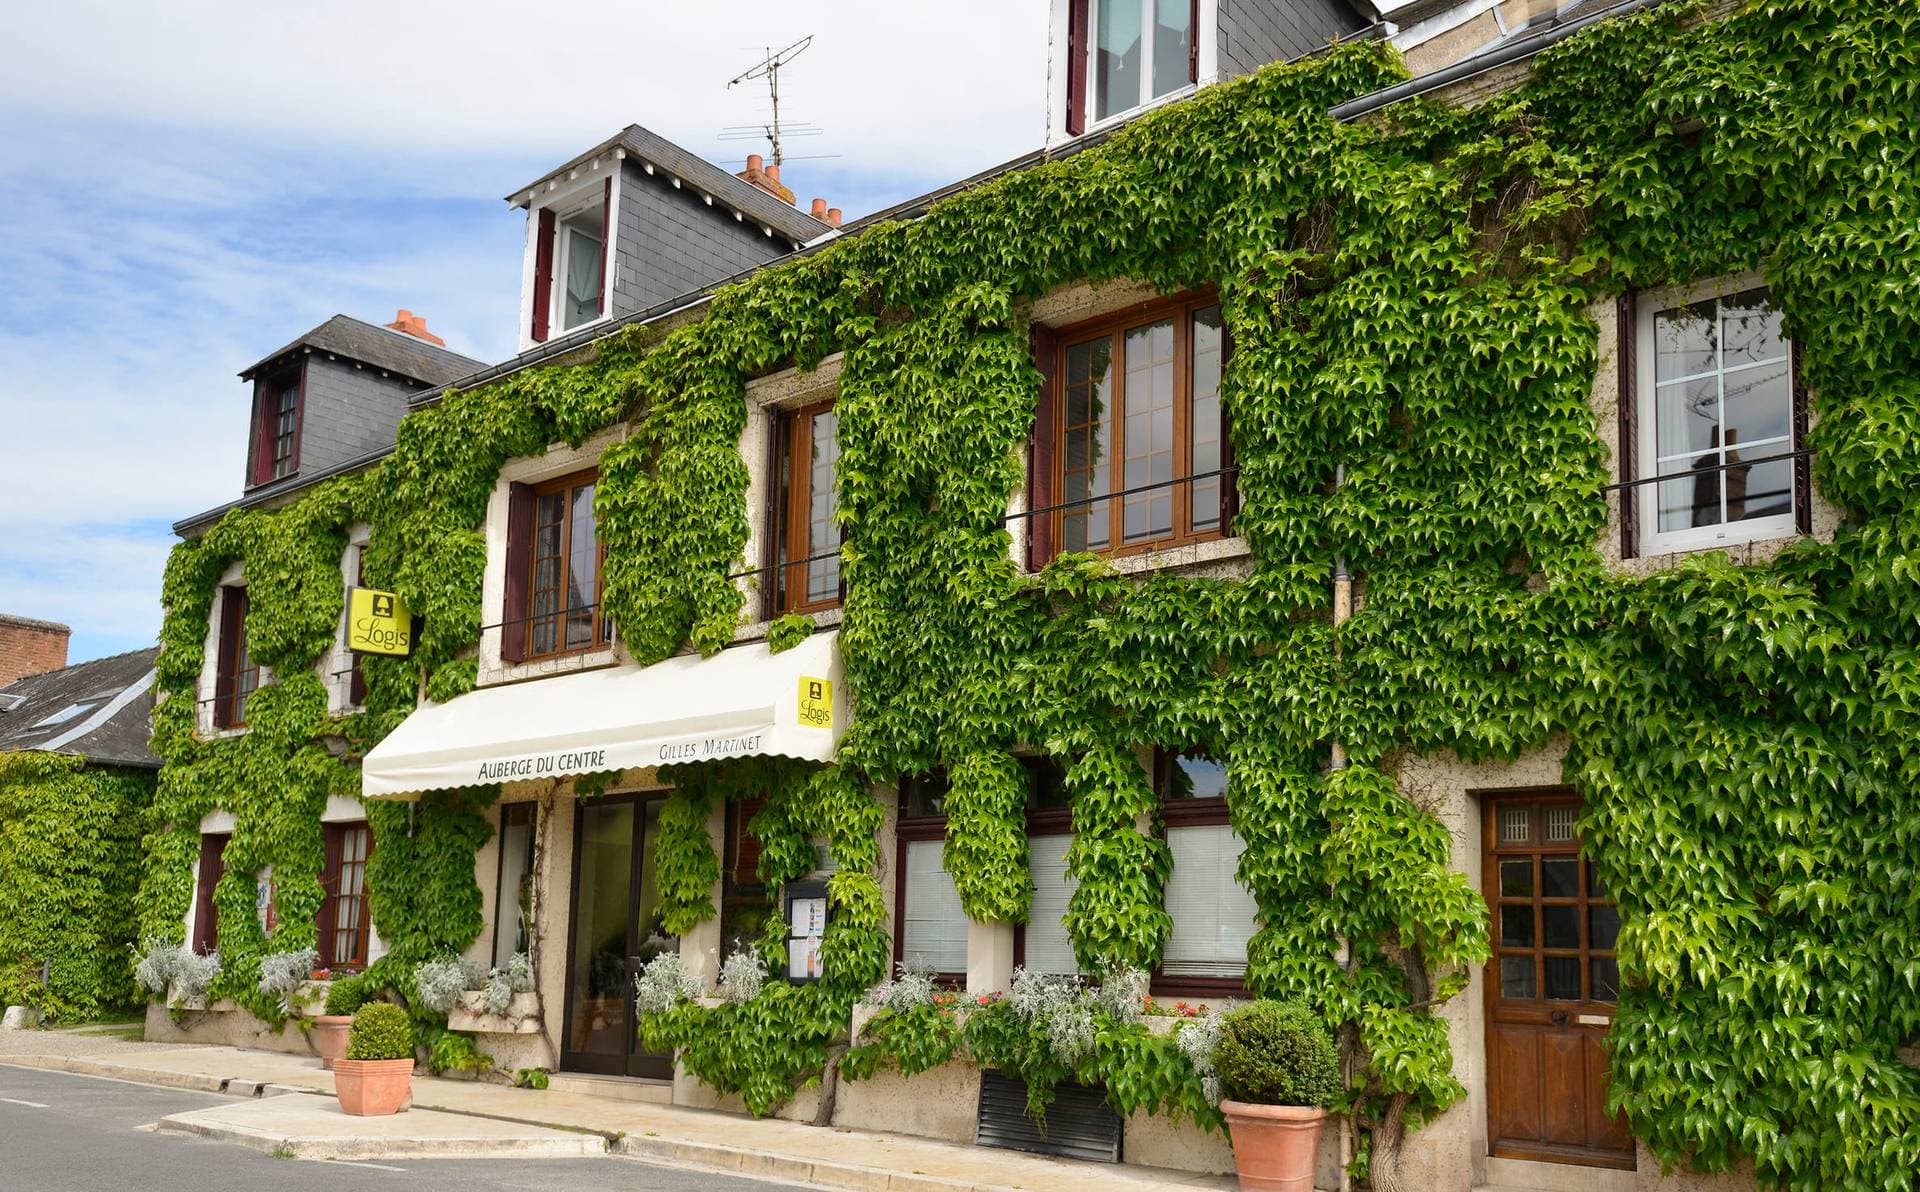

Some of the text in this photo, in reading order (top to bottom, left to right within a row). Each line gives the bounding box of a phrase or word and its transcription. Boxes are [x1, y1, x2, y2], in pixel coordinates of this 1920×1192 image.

[353, 617, 408, 651] Logis
[800, 699, 830, 725] Logis
[659, 735, 761, 760] GILLES MARTINET
[478, 750, 606, 780] AUBERGE DU CENTRE
